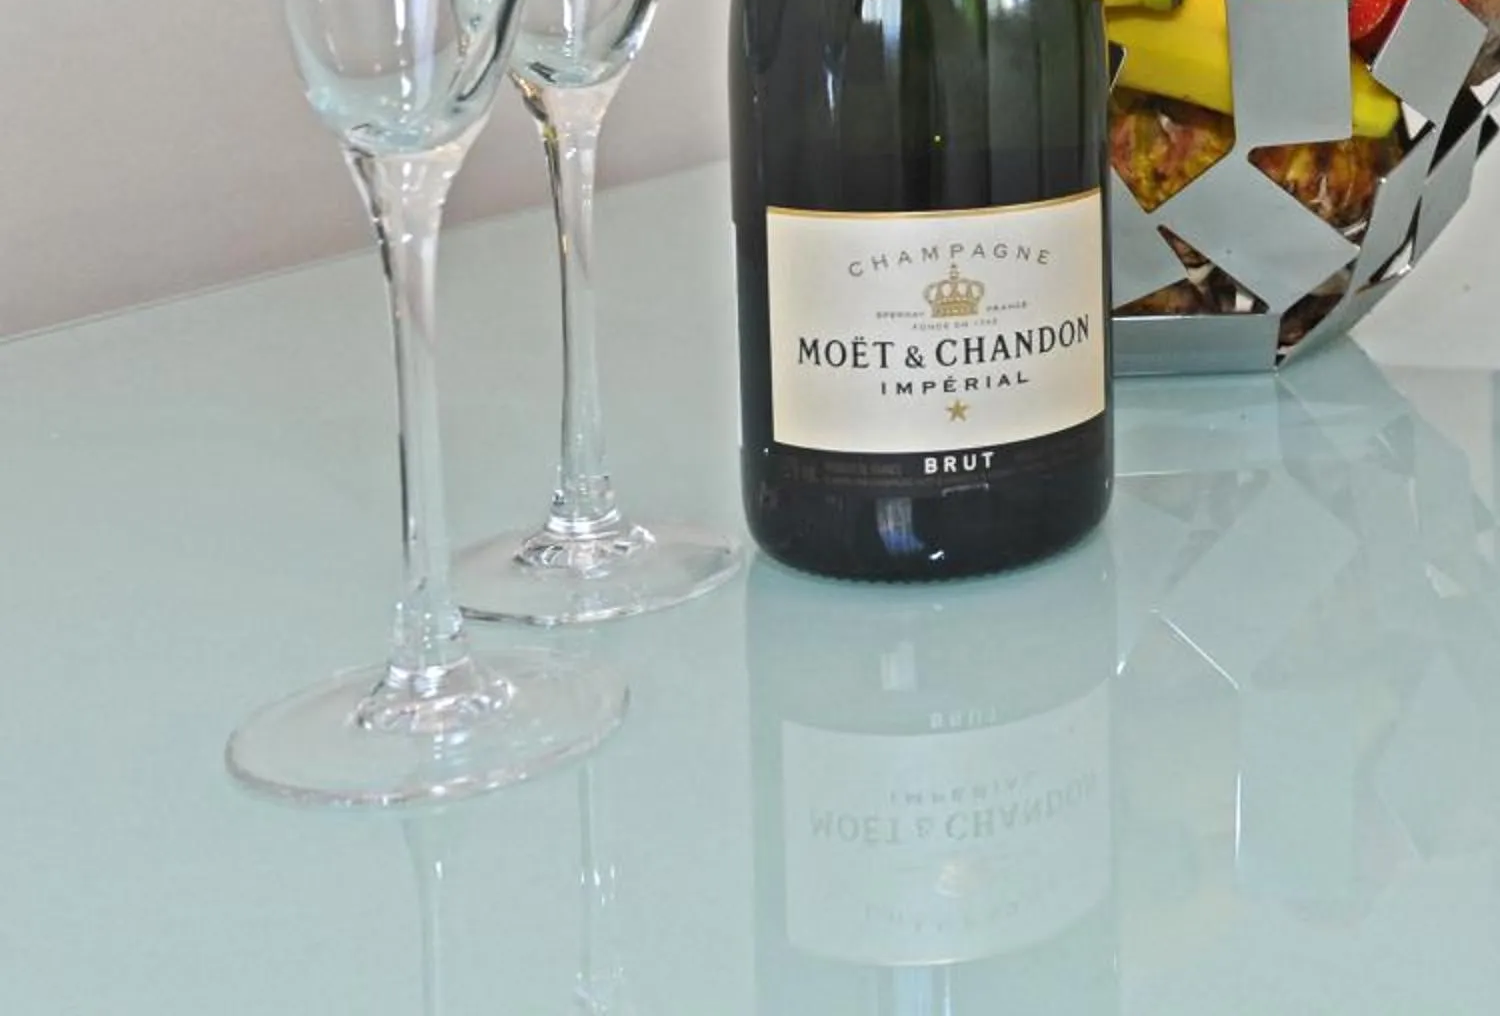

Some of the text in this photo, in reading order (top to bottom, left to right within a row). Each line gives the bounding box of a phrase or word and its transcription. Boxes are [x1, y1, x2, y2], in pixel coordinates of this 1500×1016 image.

[848, 241, 1051, 277] CHAMPAGNE
[798, 336, 895, 369] MOËT
[904, 344, 925, 369] &
[935, 313, 1089, 367] CHANDON
[881, 371, 1029, 395] IMPÉRIAL
[924, 452, 995, 474] BRUT
